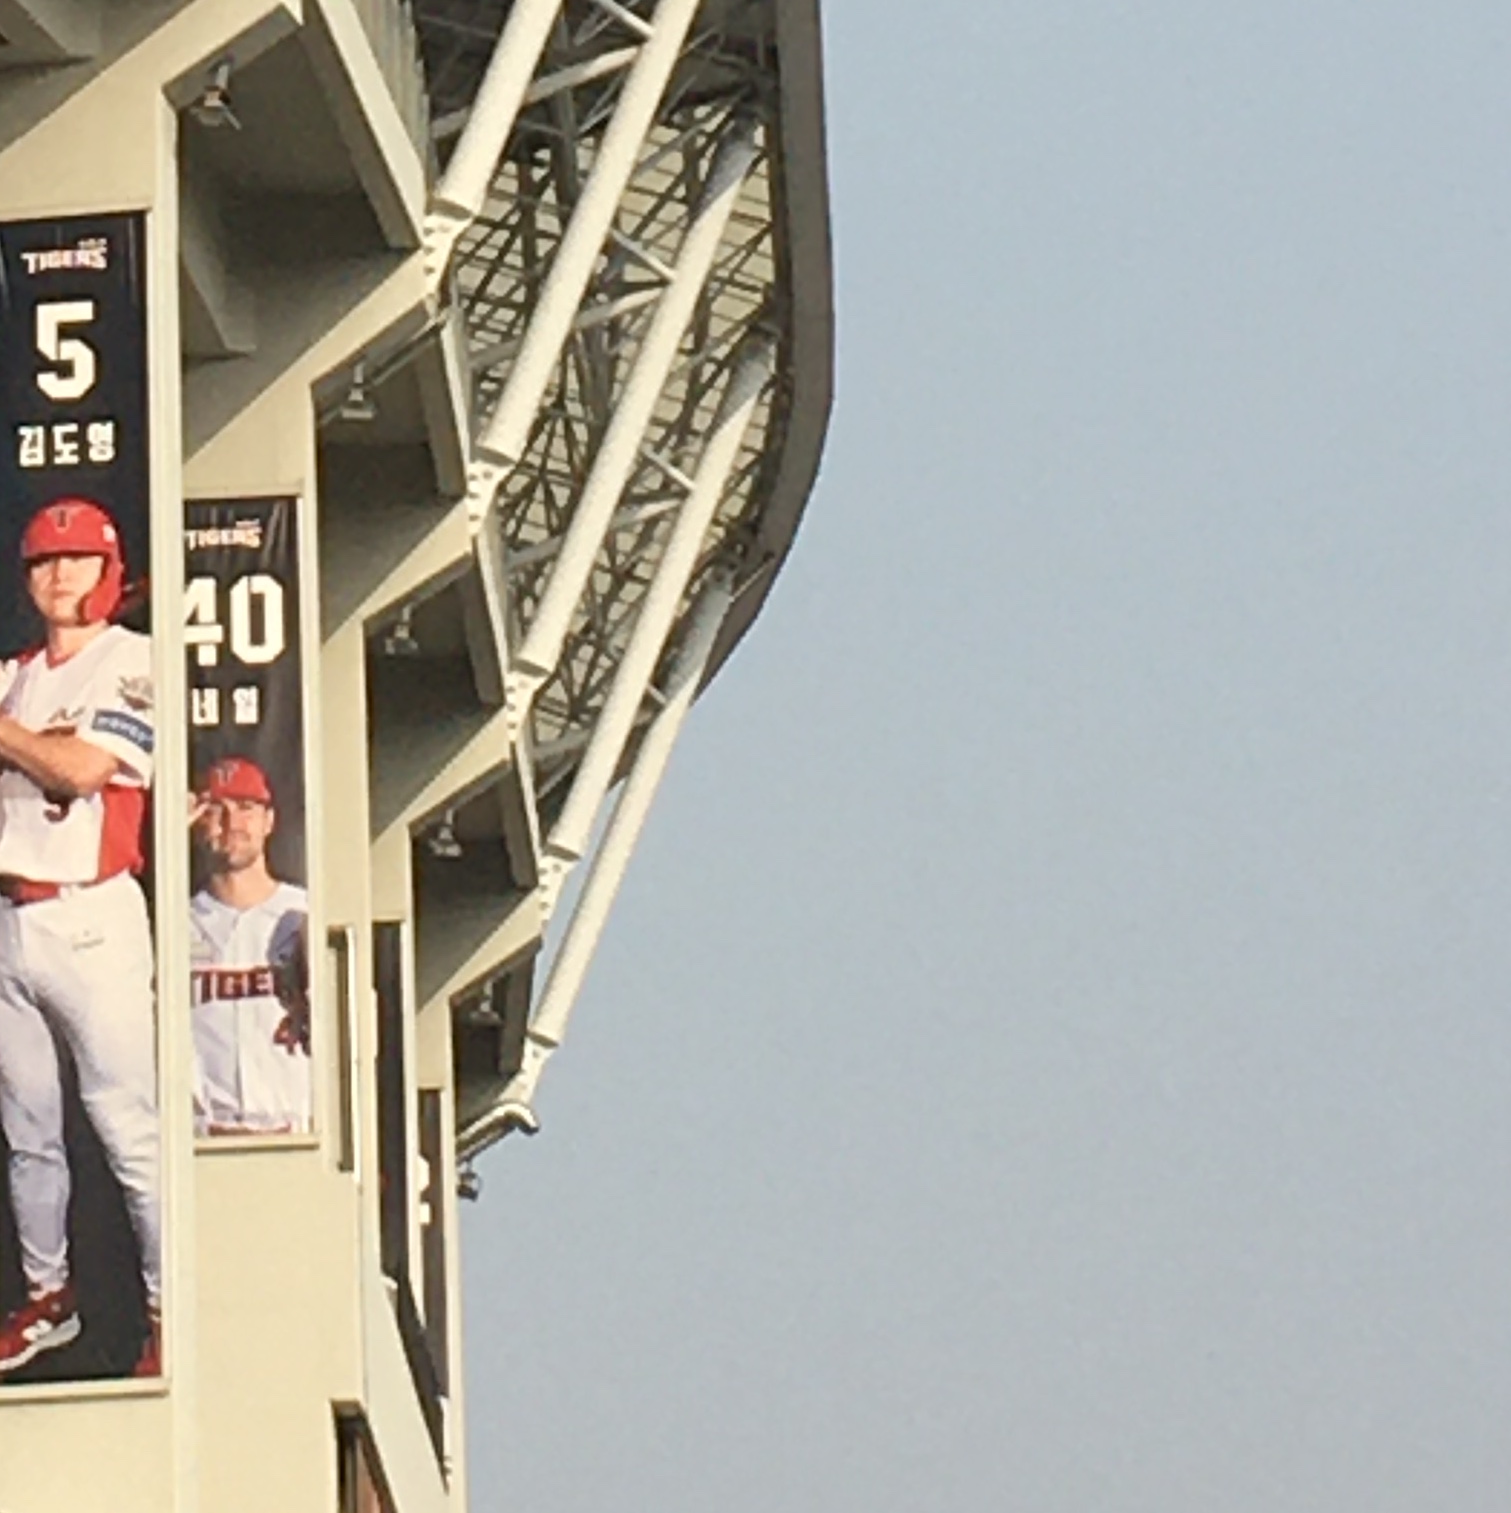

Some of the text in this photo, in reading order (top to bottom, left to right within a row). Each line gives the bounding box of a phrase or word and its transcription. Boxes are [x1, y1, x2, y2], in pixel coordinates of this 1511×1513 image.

[19, 248, 108, 275] TIGERS
[37, 300, 96, 400] 5
[16, 420, 116, 467] 김도영
[184, 574, 286, 666] 40
[190, 967, 278, 1004] TIGE
